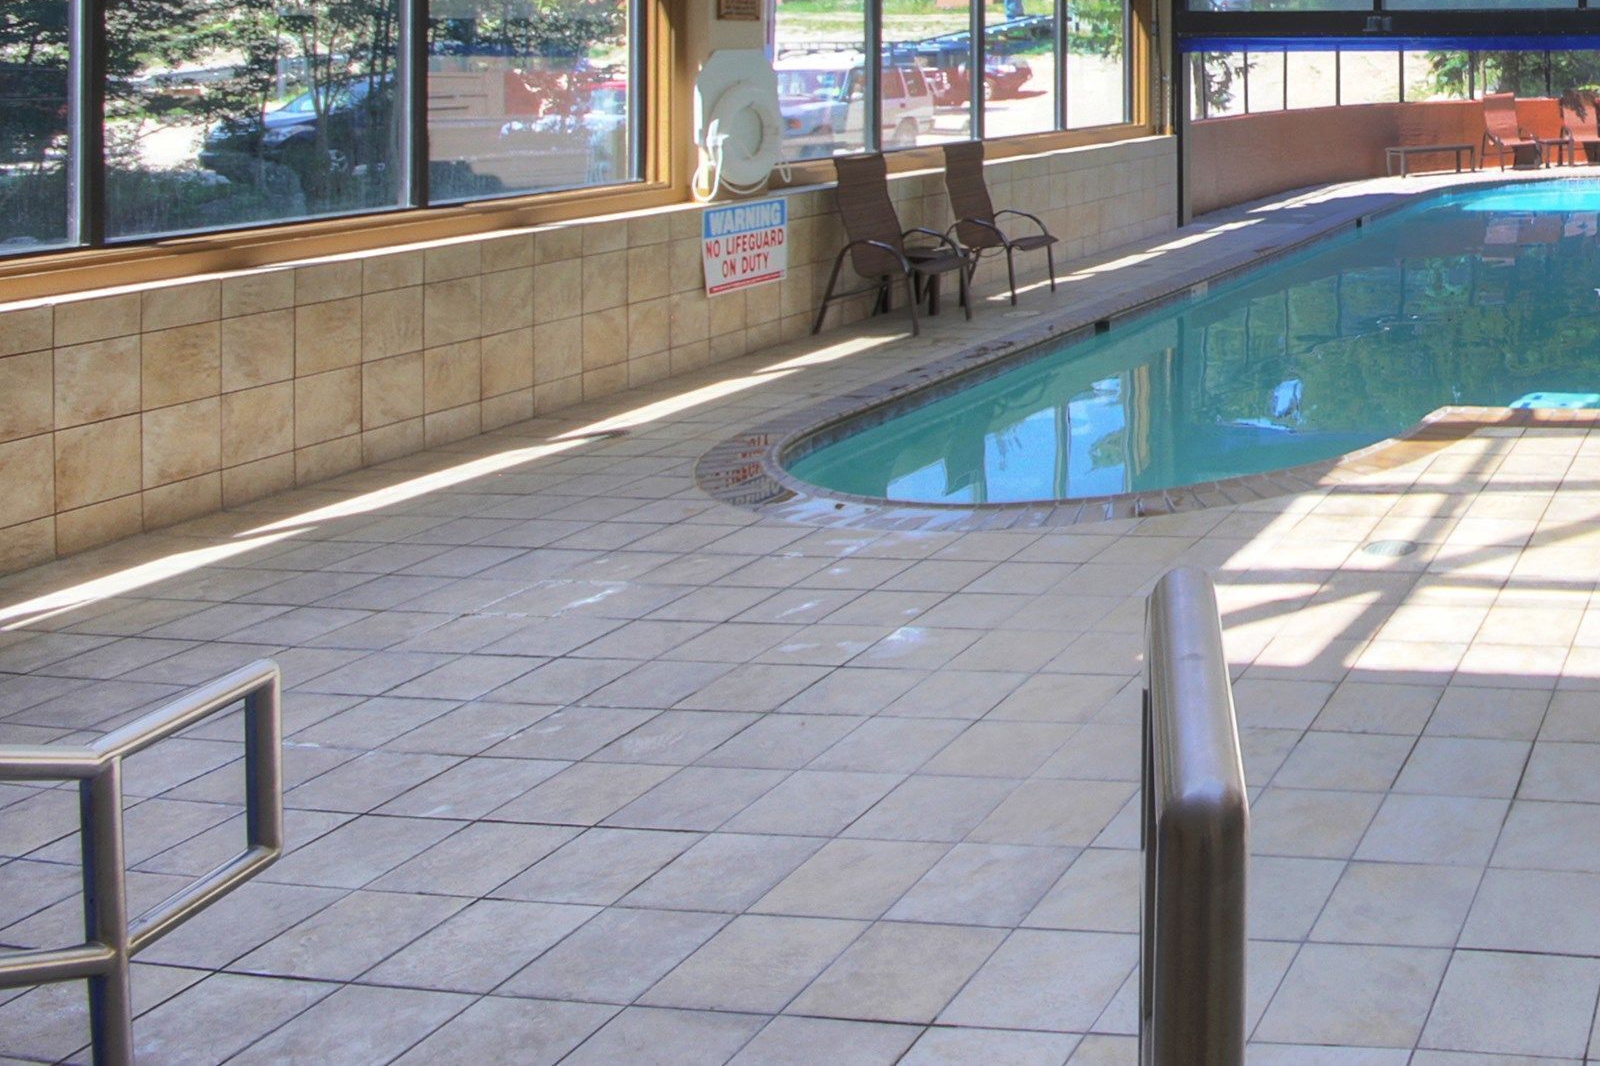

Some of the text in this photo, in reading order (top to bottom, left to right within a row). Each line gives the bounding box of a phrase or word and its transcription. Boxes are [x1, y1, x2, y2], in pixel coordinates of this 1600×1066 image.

[709, 203, 781, 235] WARNING
[706, 228, 784, 259] NO LIFEGUARD
[722, 252, 769, 278] ON DUTY
